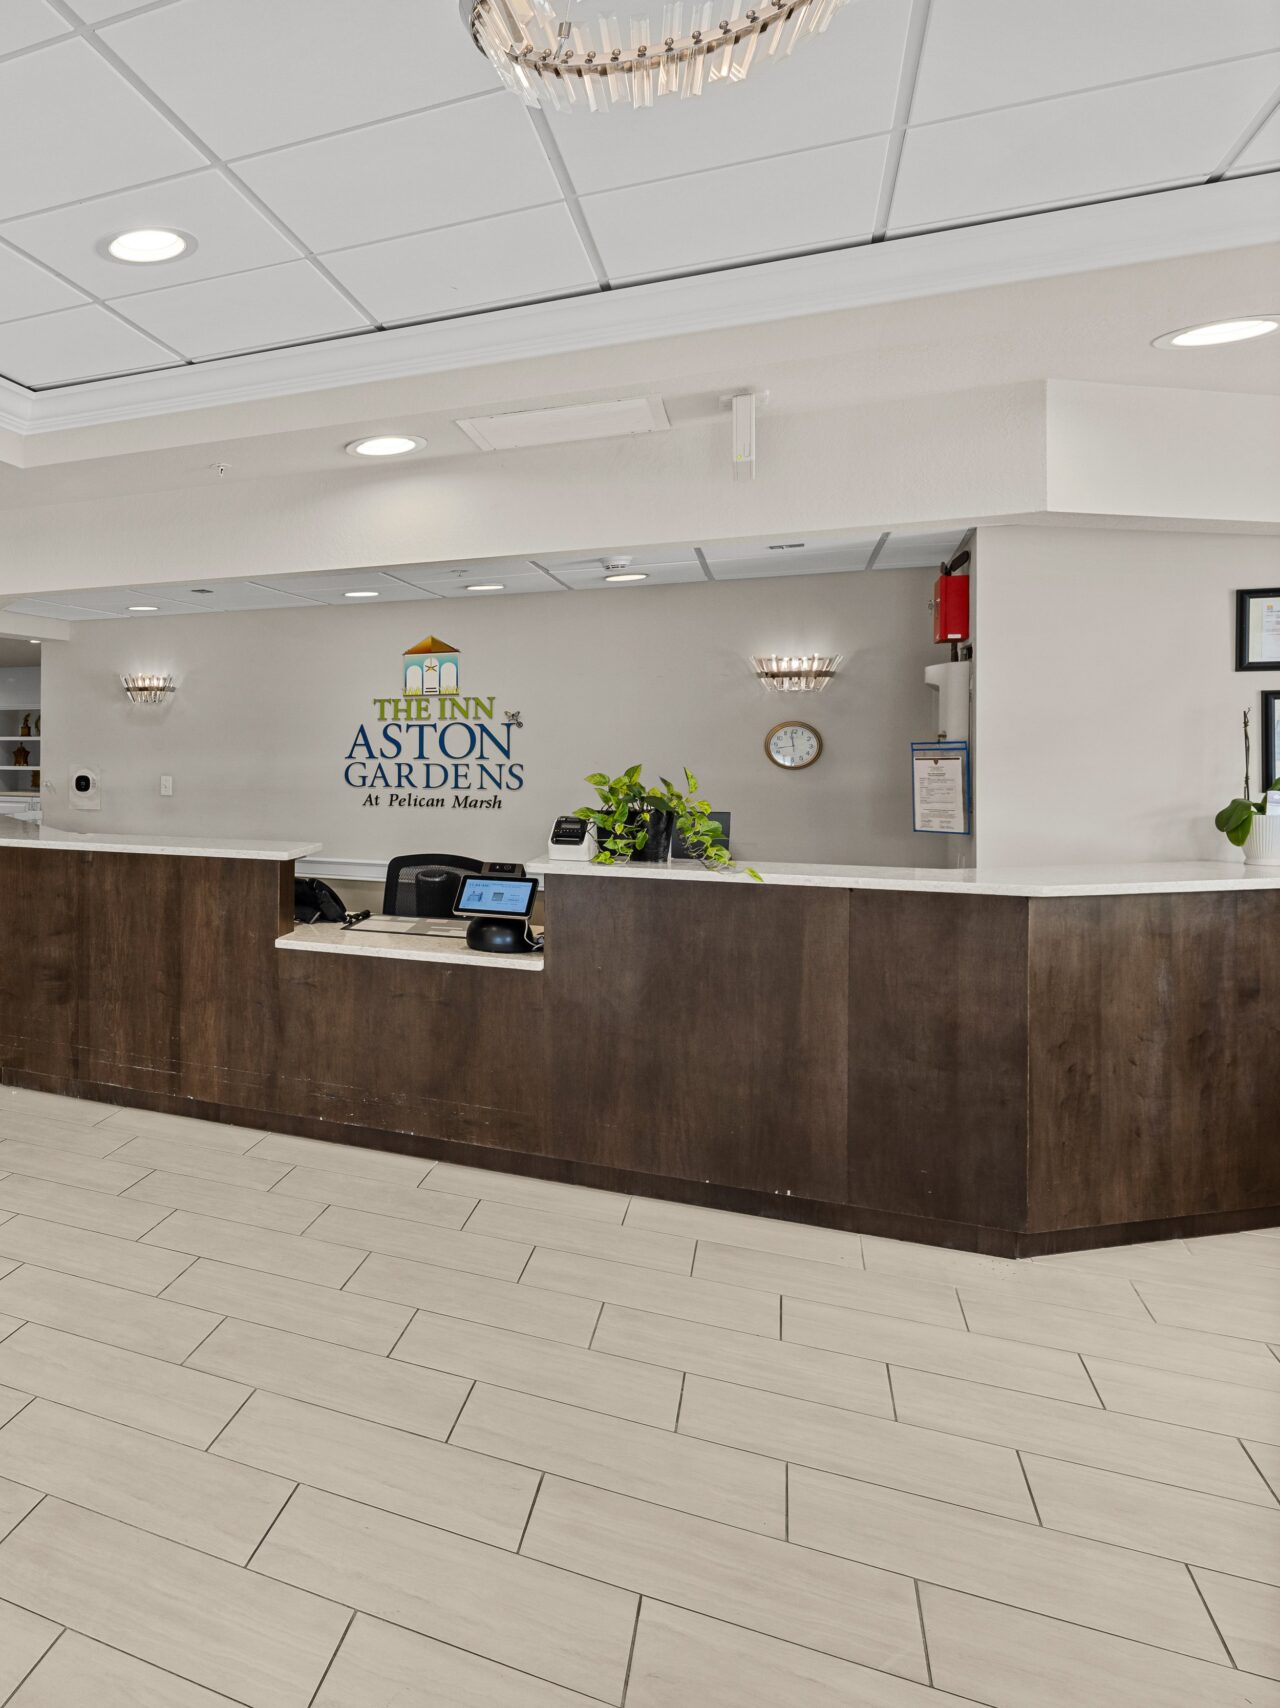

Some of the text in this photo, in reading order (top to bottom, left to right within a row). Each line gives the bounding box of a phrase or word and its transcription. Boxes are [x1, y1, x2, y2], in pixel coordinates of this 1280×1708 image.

[373, 696, 496, 722] THE INN
[345, 722, 516, 760] ASTON
[344, 762, 525, 791] GARDENS
[362, 793, 503, 809] At Pelican Marsh
